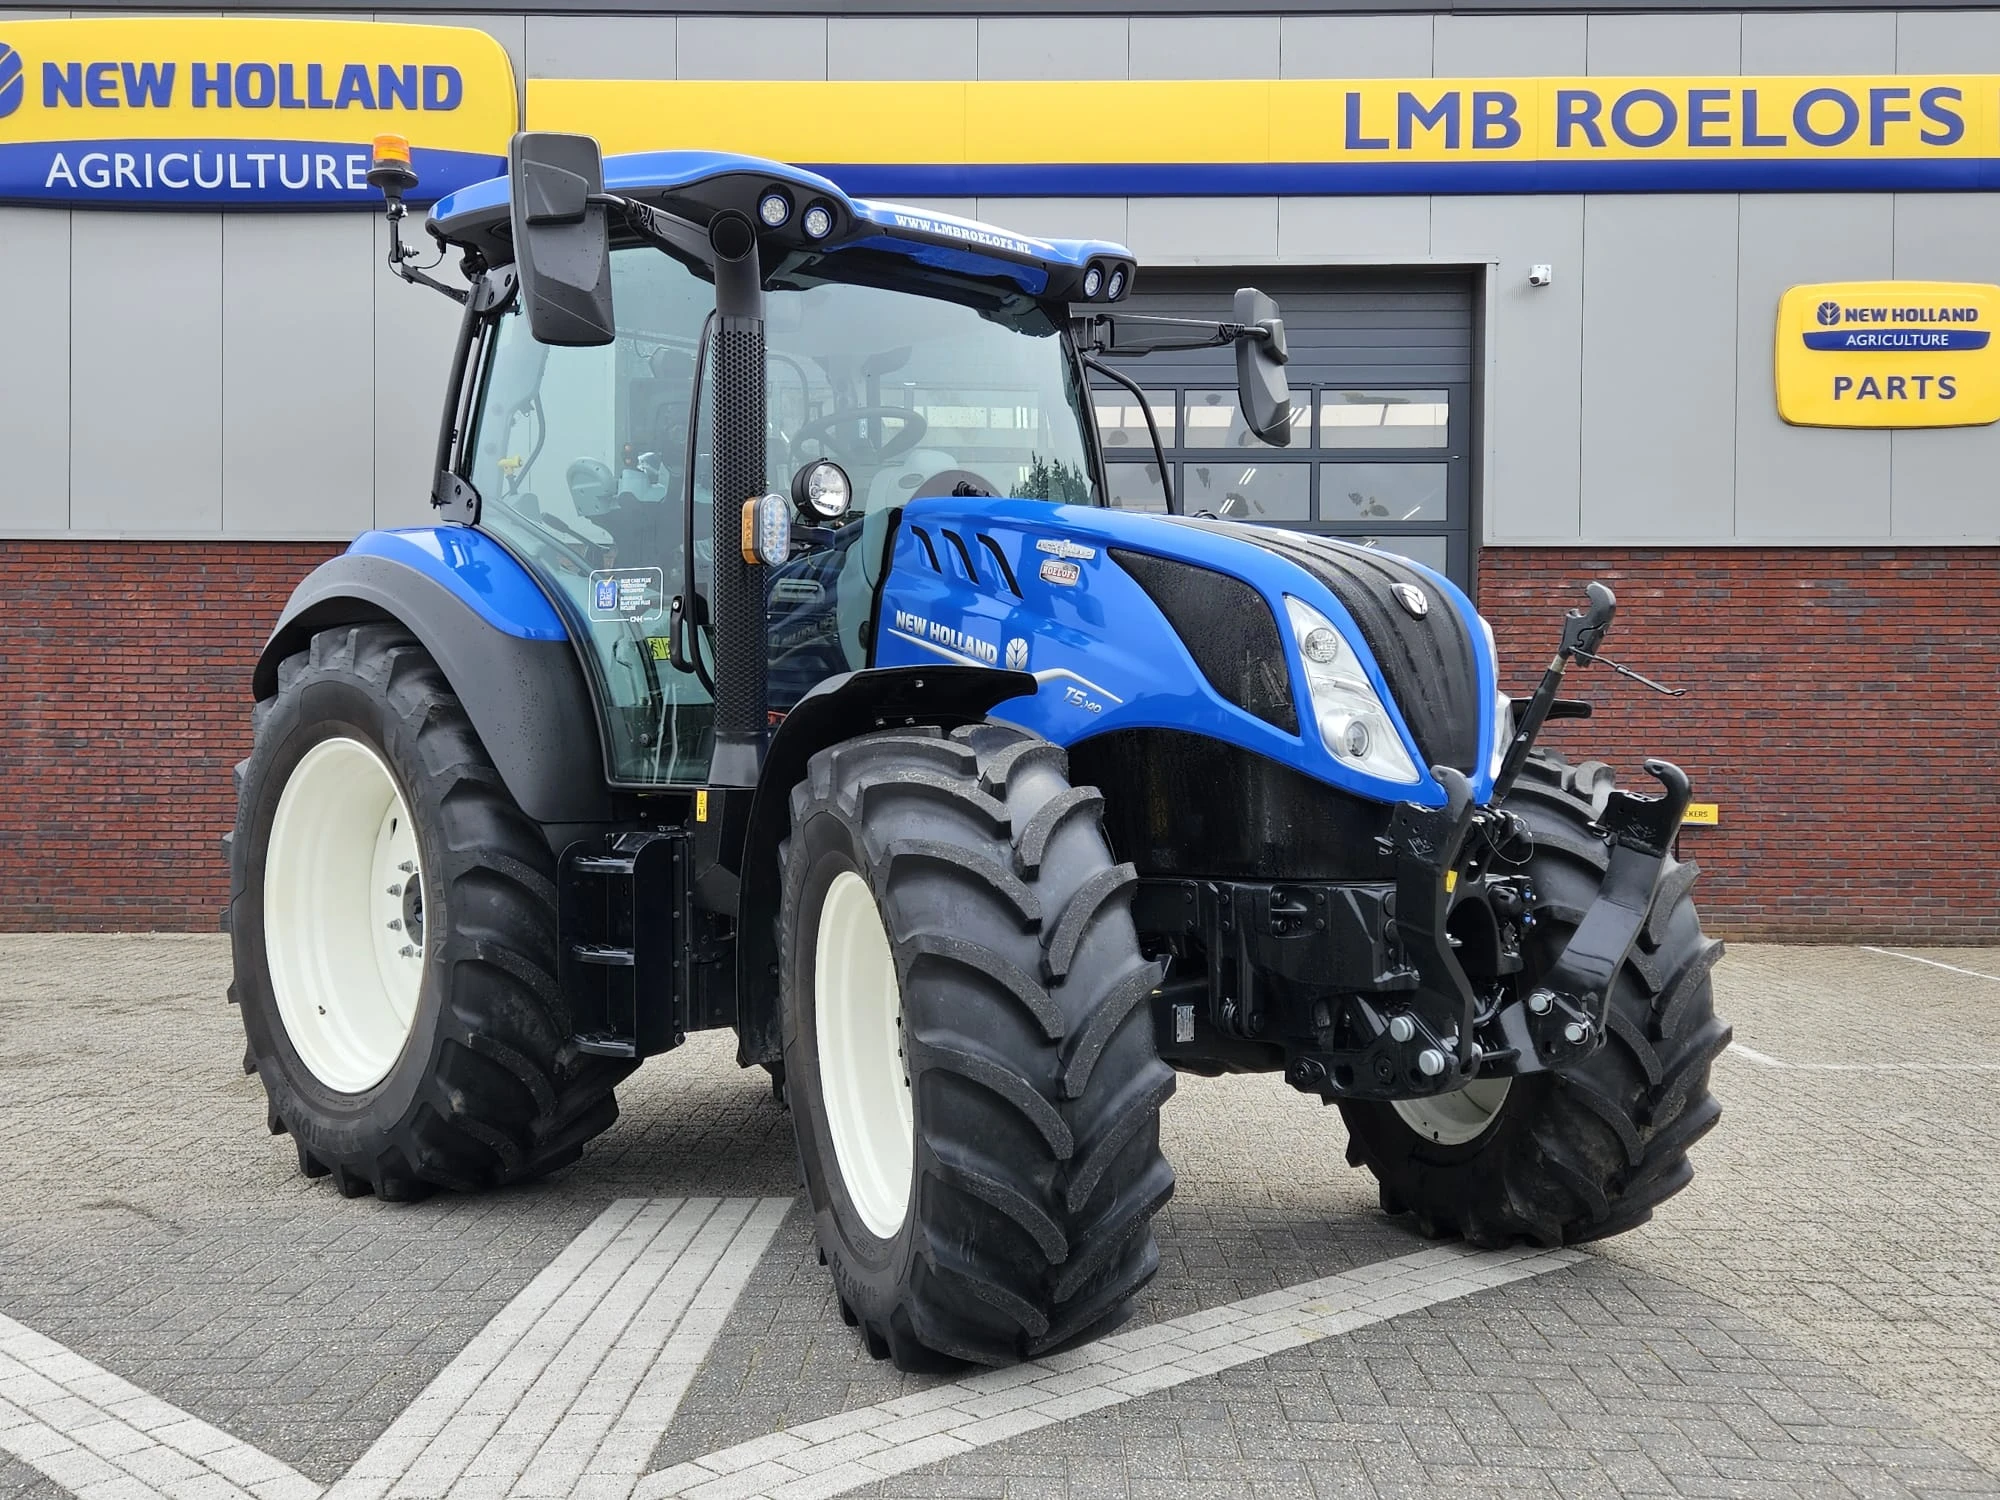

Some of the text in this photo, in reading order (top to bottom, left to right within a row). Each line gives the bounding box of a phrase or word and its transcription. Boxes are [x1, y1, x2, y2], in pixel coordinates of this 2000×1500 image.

[42, 62, 464, 111] NEW HOLLAND
[1344, 86, 1966, 150] LMB ROELOFS
[45, 152, 368, 190] AGRICULTURE
[894, 213, 1032, 254] WWW.LMBROELOFS.NL
[1844, 307, 1980, 323] NEW HOLLAND
[1845, 334, 1949, 346] AGRICULTURE
[1833, 375, 1957, 401] PARTS
[1042, 564, 1077, 580] ROELOFS
[895, 609, 999, 665] NEW HOLLAND
